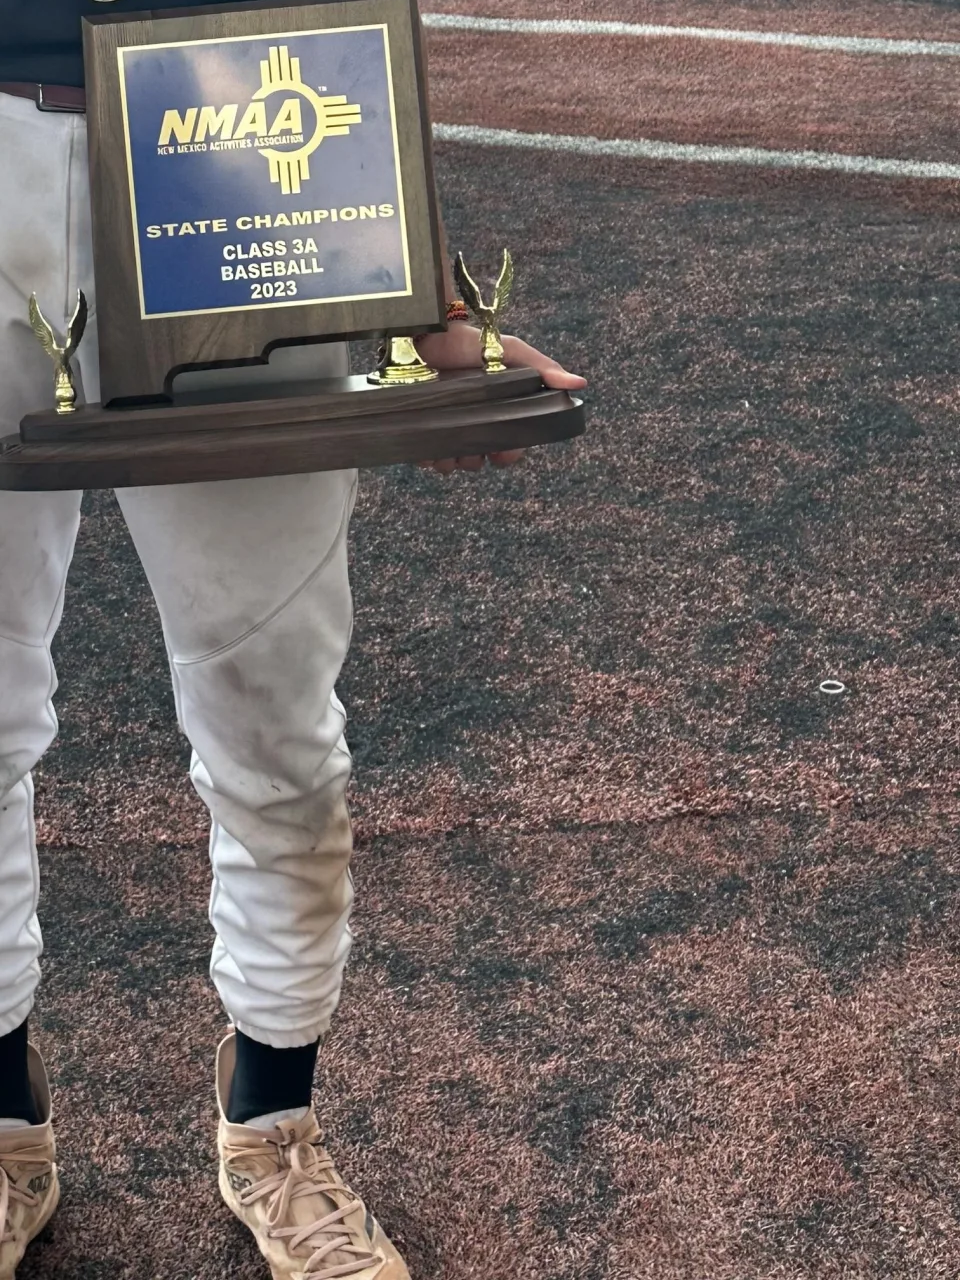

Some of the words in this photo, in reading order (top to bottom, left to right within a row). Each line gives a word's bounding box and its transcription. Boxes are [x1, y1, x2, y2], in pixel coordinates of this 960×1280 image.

[158, 98, 302, 146] NMAA
[177, 143, 207, 154] MEXICO
[209, 138, 253, 151] ACTIVITIES
[253, 133, 304, 147] ASSOCIATION
[146, 218, 228, 239] STATE
[236, 203, 395, 231] CHAMPIONS
[223, 240, 288, 261] CLASS
[292, 237, 319, 254] 3A
[221, 258, 324, 281] BASEBALL
[250, 280, 298, 300] 2023
